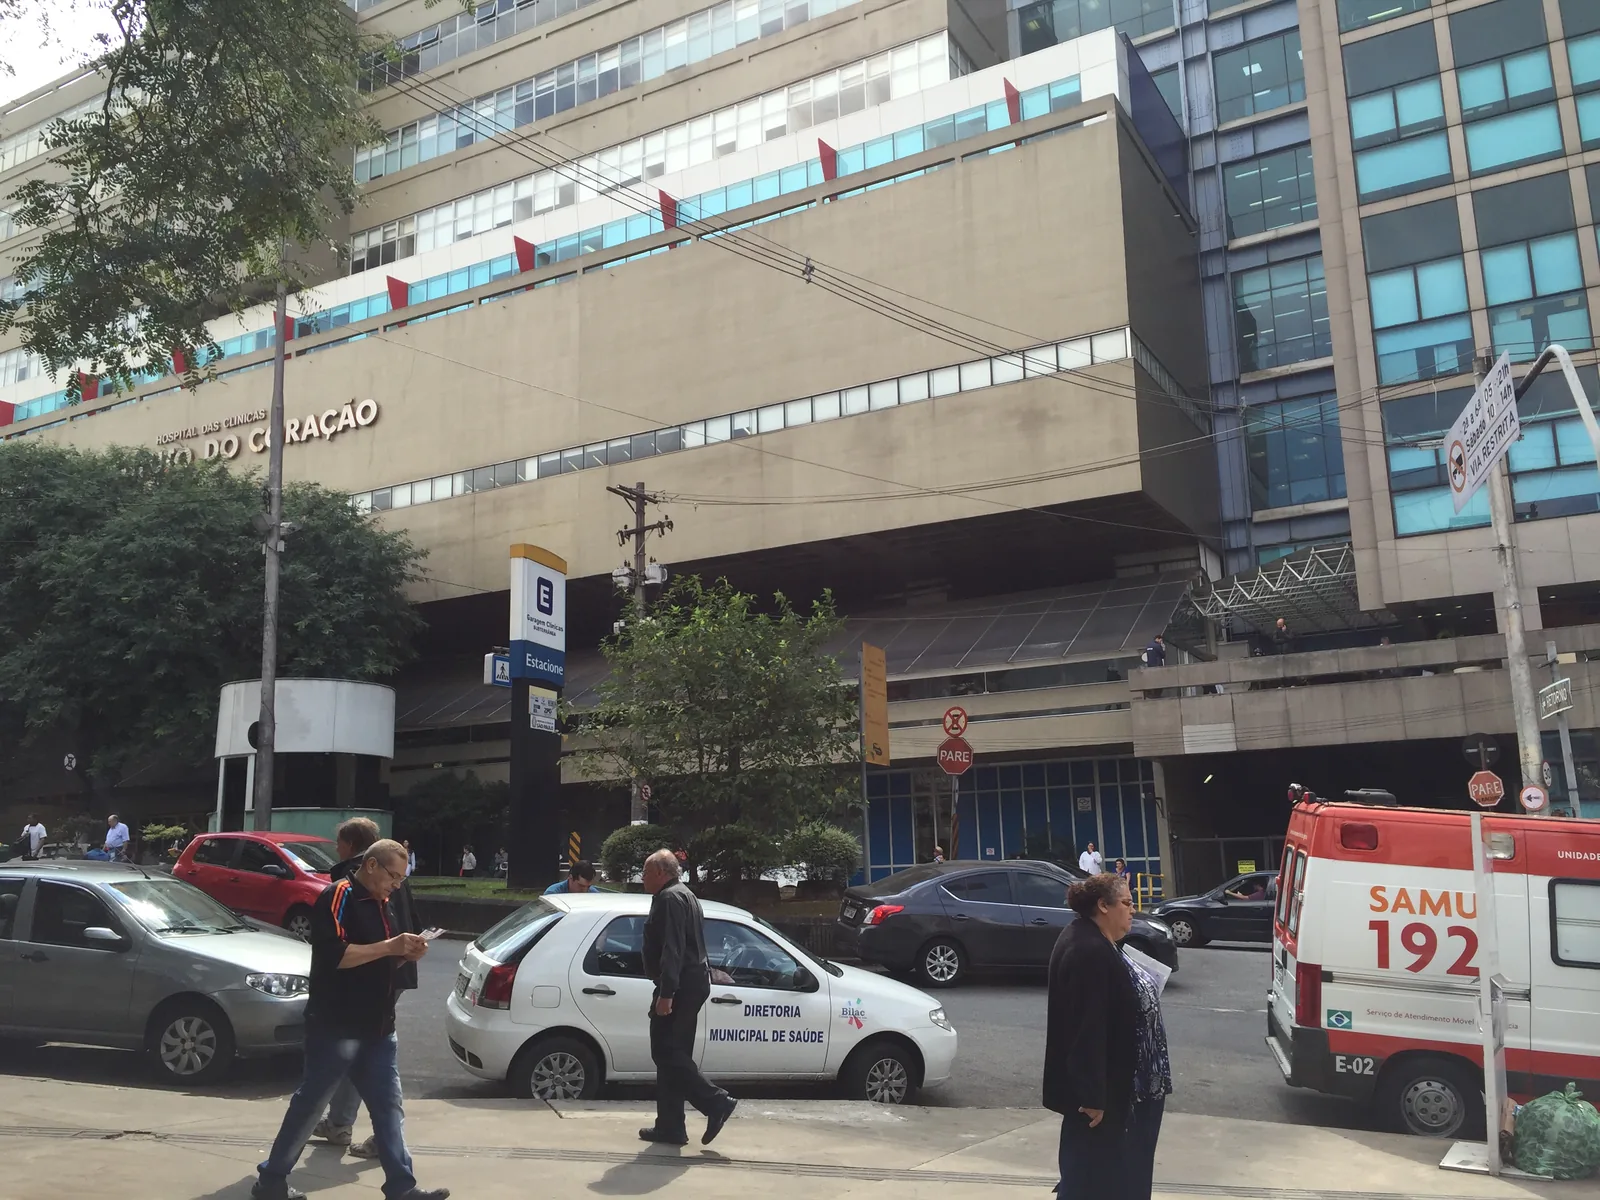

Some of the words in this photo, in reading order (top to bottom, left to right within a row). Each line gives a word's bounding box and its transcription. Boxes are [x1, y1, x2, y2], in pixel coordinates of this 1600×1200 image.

[1484, 383, 1493, 403] 05
[1497, 363, 1509, 387] 21h
[1466, 419, 1486, 453] Sábado
[1487, 403, 1495, 421] 10
[1500, 383, 1512, 405] 14h
[156, 427, 198, 445] HOSPITAL
[201, 420, 220, 434] DAS
[1470, 456, 1483, 477] VIA
[1482, 410, 1516, 459] RESTRITA
[204, 434, 240, 461] DO
[540, 584, 550, 608] E
[526, 653, 564, 675] Estacione
[940, 750, 970, 763] PARE
[1471, 781, 1502, 797] PARE
[1369, 885, 1477, 920] SAMU
[1368, 920, 1480, 977] 192
[744, 1004, 801, 1018] DIRETORIA
[841, 1007, 866, 1016] Bilac
[1366, 1008, 1392, 1019] Serviço
[1394, 1010, 1403, 1019] de
[1404, 1012, 1451, 1023] Atendimento
[709, 1028, 768, 1042] MUNICIPAL
[772, 1030, 786, 1042] DE
[788, 1027, 824, 1043] SAÚDE
[1335, 1055, 1375, 1075] E-02
